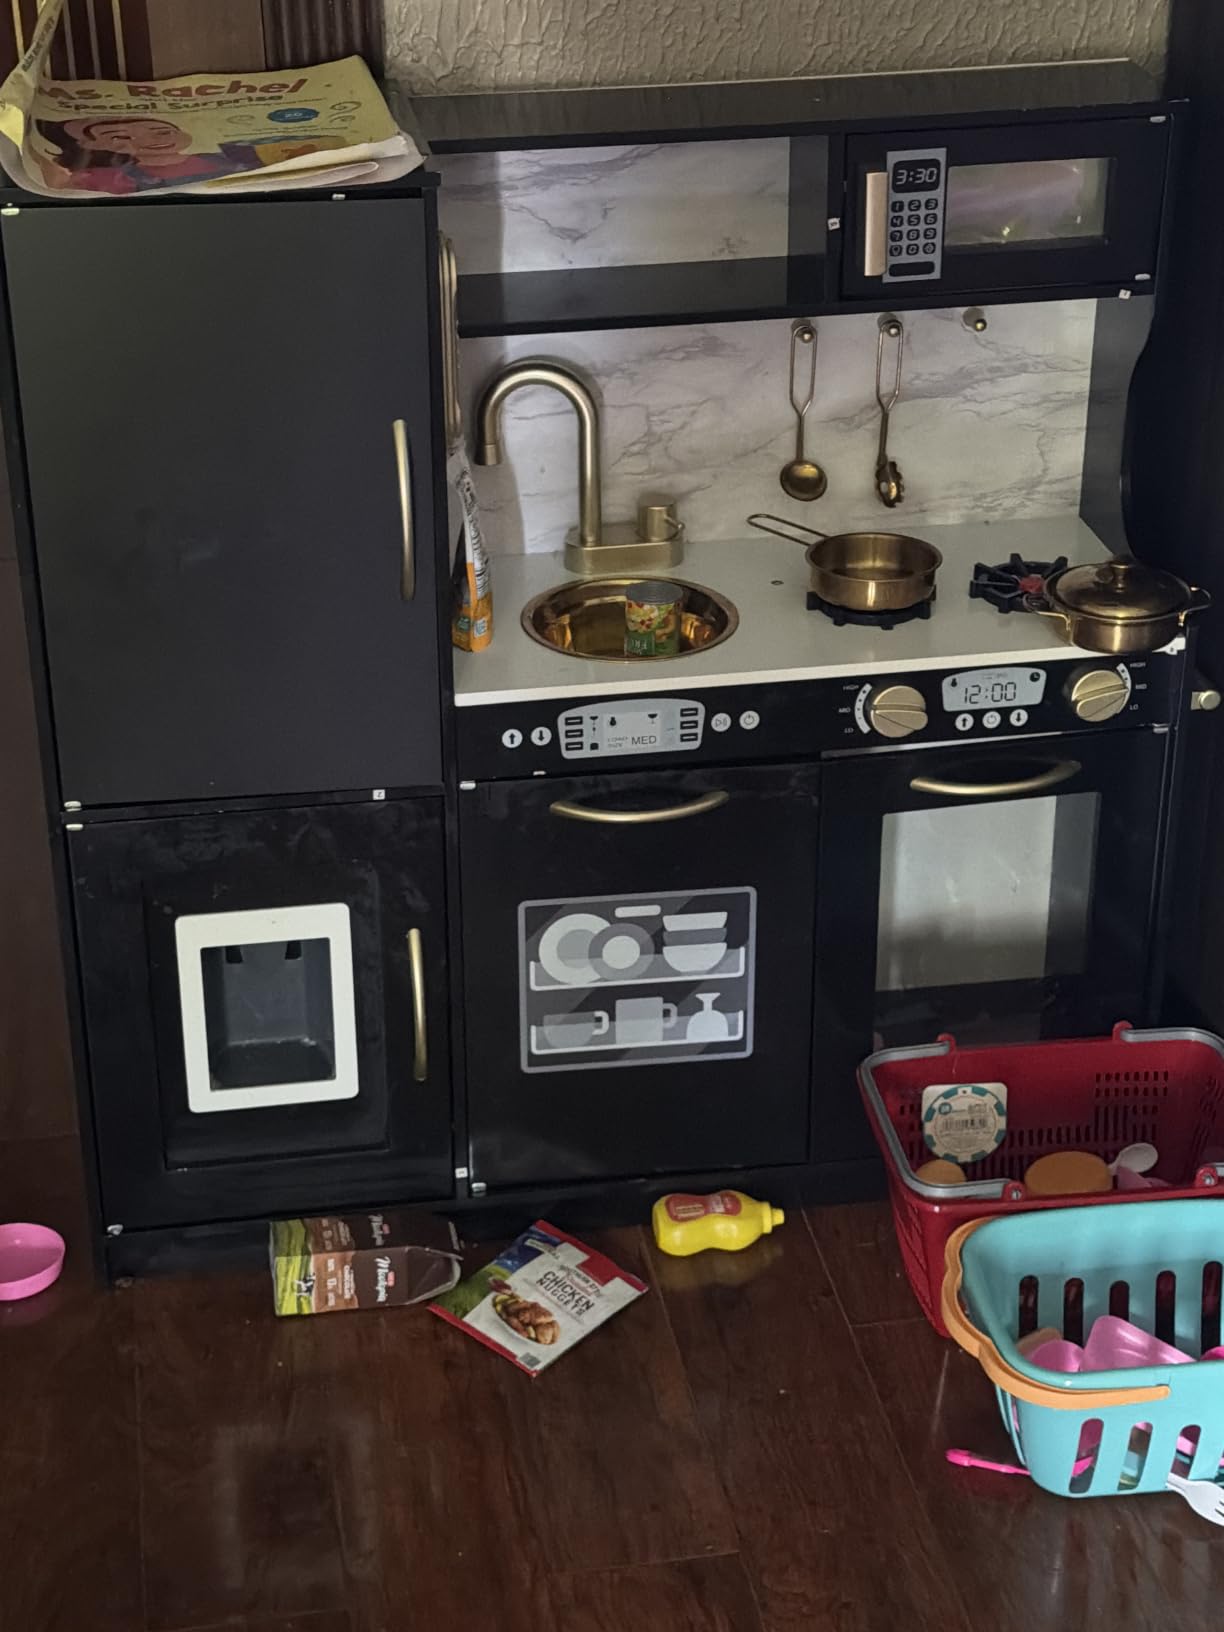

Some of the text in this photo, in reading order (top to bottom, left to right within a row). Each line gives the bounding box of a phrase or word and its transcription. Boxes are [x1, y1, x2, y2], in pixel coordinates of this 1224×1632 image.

[127, 78, 309, 98] Rachel
[57, 101, 157, 111] Special
[168, 95, 283, 109] Surprise
[895, 167, 938, 185] 3:30
[911, 201, 919, 210] 2
[892, 214, 935, 226] 4 5 6
[964, 681, 1017, 704] 12:00
[631, 735, 657, 746] MED
[535, 1276, 586, 1316] NUGGETS
[543, 1270, 595, 1311] CHICKEN
